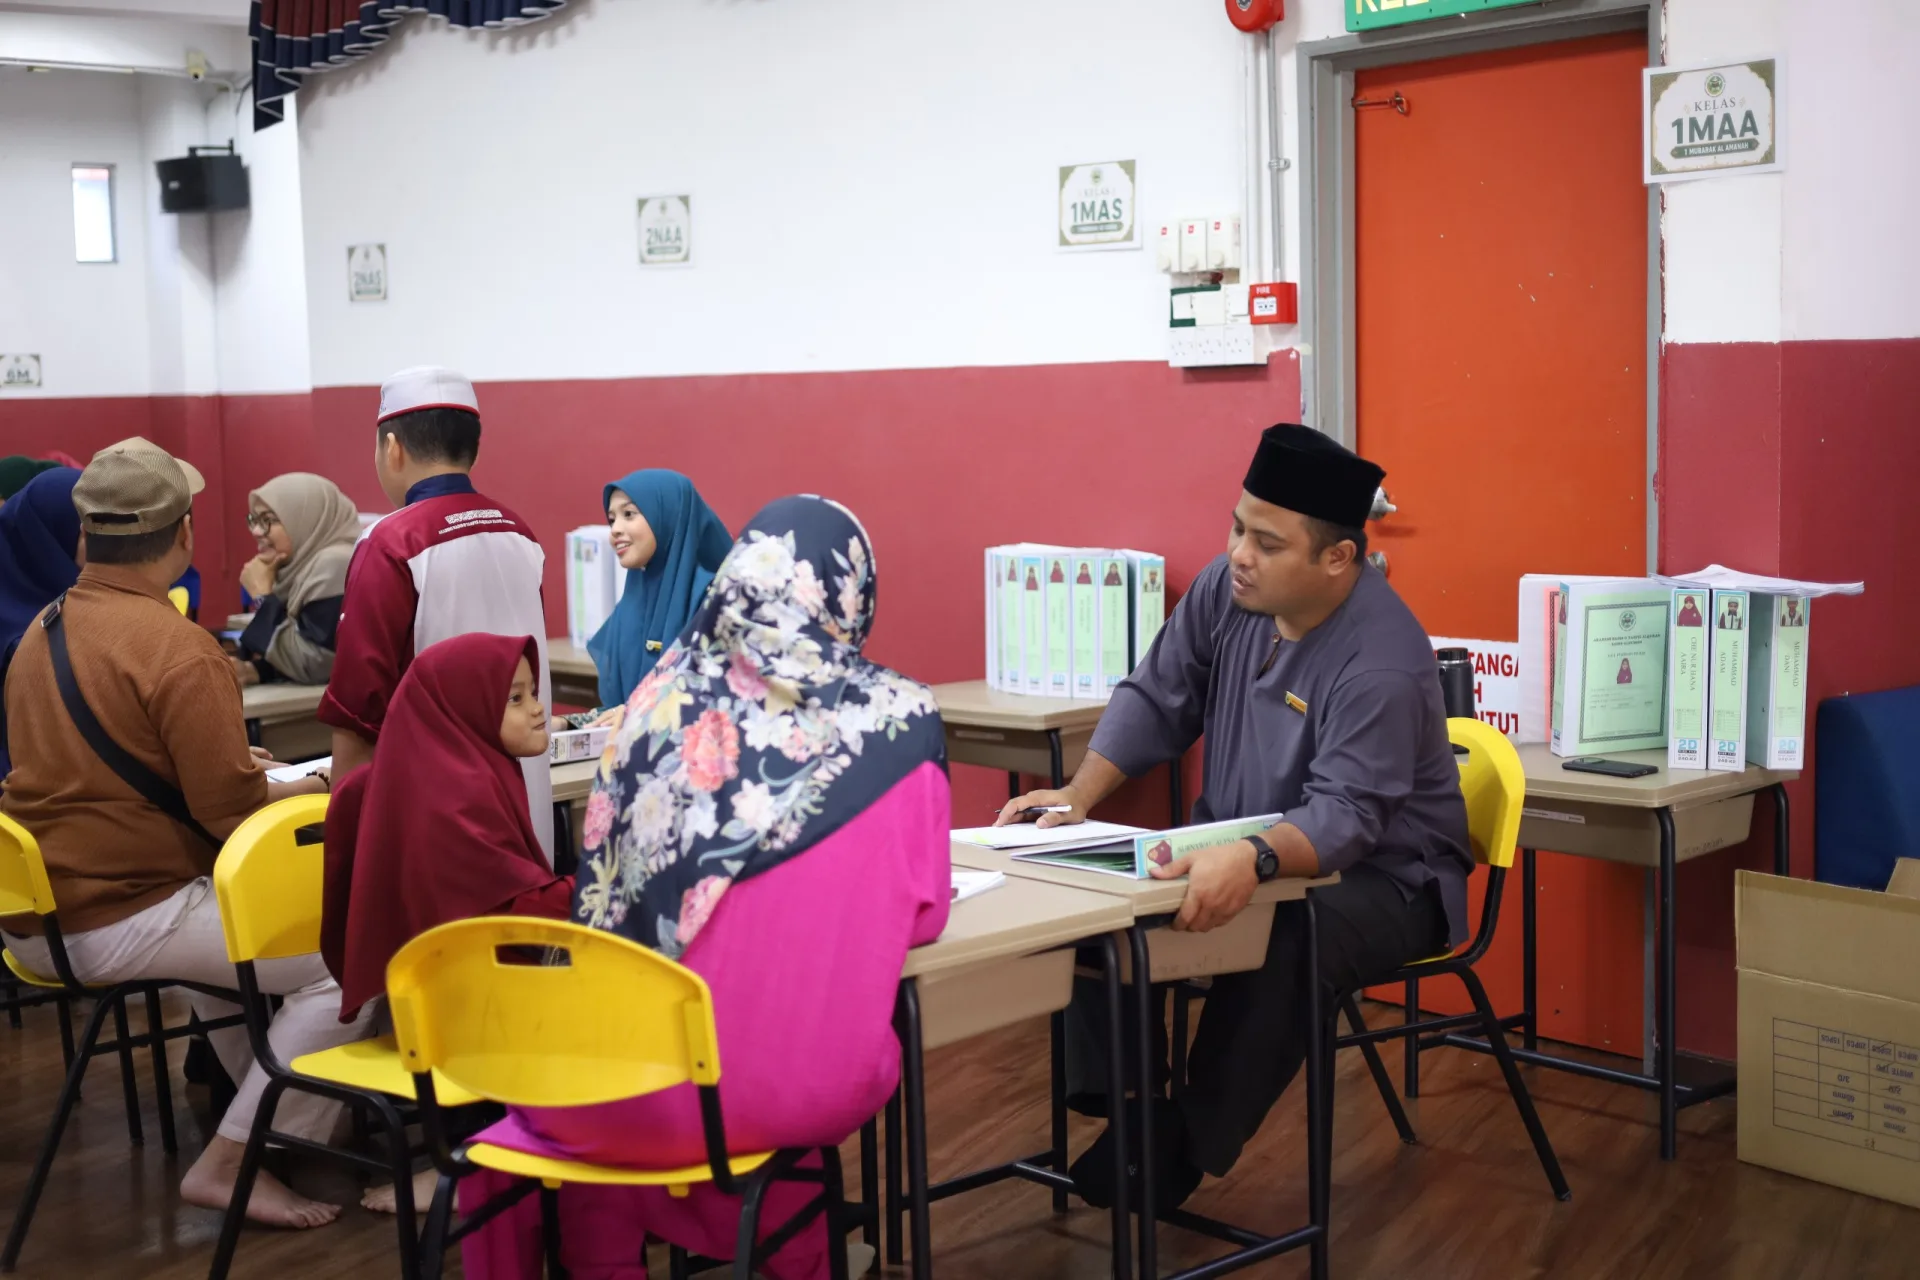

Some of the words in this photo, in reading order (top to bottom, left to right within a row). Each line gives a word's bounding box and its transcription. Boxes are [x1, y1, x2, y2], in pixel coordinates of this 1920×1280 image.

[1694, 97, 1736, 112] KELAS
[1671, 109, 1760, 144] 1MAA
[1689, 144, 1717, 155] MUBARAK
[1717, 142, 1725, 152] AL
[1725, 141, 1749, 151] AMANAH
[1070, 197, 1123, 223] 1MAS
[1256, 286, 1270, 294] FIRE
[1730, 640, 1738, 687] MUHAMMAD
[1792, 640, 1800, 688] MUHAMMAD
[1689, 670, 1697, 692] HANA
[1678, 739, 1698, 750] 2D
[1718, 741, 1737, 752] 2D
